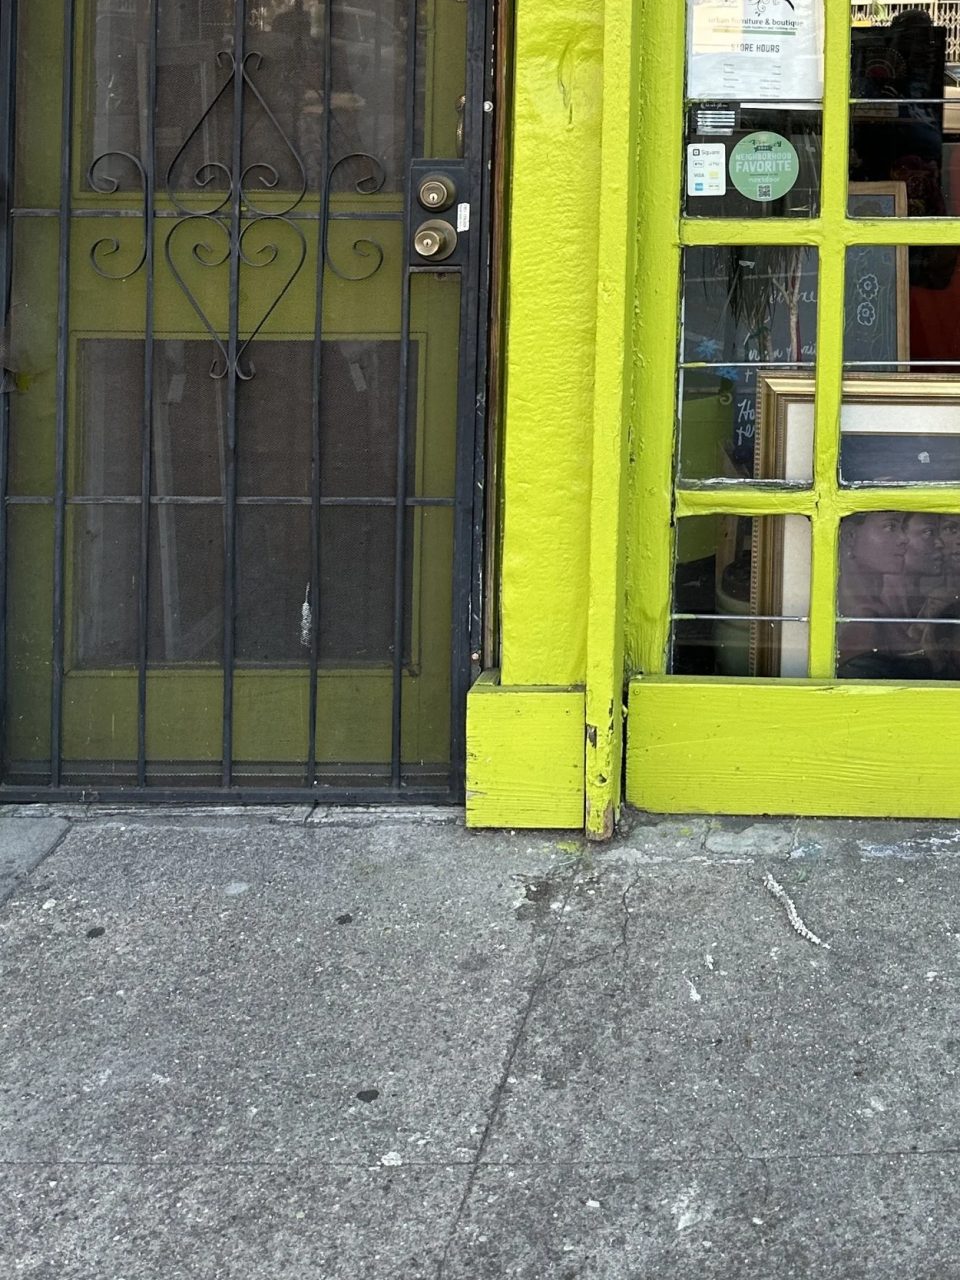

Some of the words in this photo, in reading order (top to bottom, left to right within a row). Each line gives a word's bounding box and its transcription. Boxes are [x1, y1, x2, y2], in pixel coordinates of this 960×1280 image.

[772, 18, 804, 28] boutique
[756, 44, 780, 53] HOURS
[735, 152, 792, 160] NEIGHBORHOOD
[735, 160, 792, 172] FAVORITE
